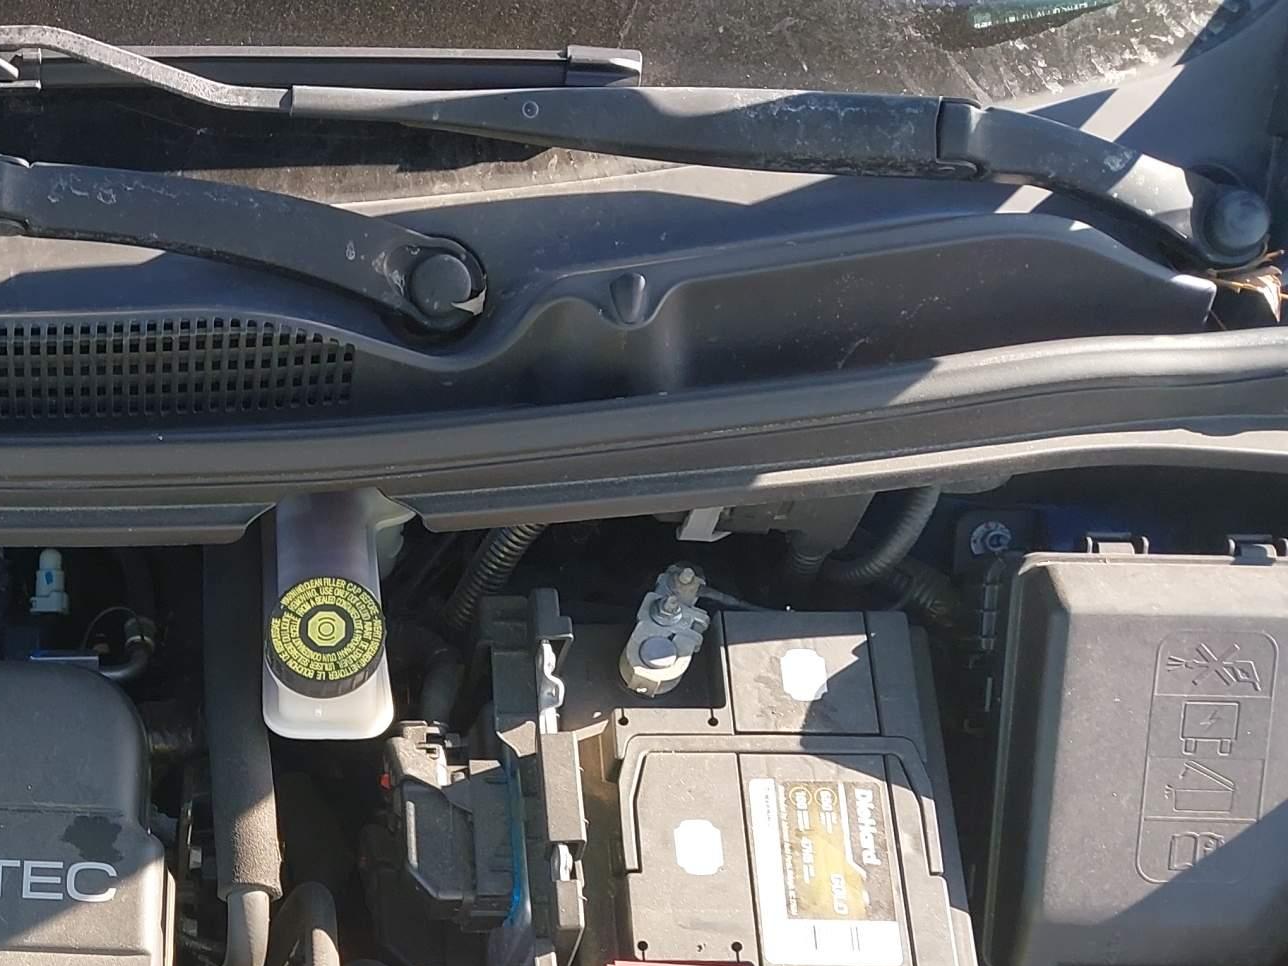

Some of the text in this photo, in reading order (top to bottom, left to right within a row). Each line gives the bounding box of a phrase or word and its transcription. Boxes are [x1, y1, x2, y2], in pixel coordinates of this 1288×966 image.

[323, 578, 346, 588] FILLER
[318, 586, 333, 595] USE
[345, 581, 362, 596] CAP
[357, 591, 379, 615] BEFORE
[315, 670, 325, 679] LE
